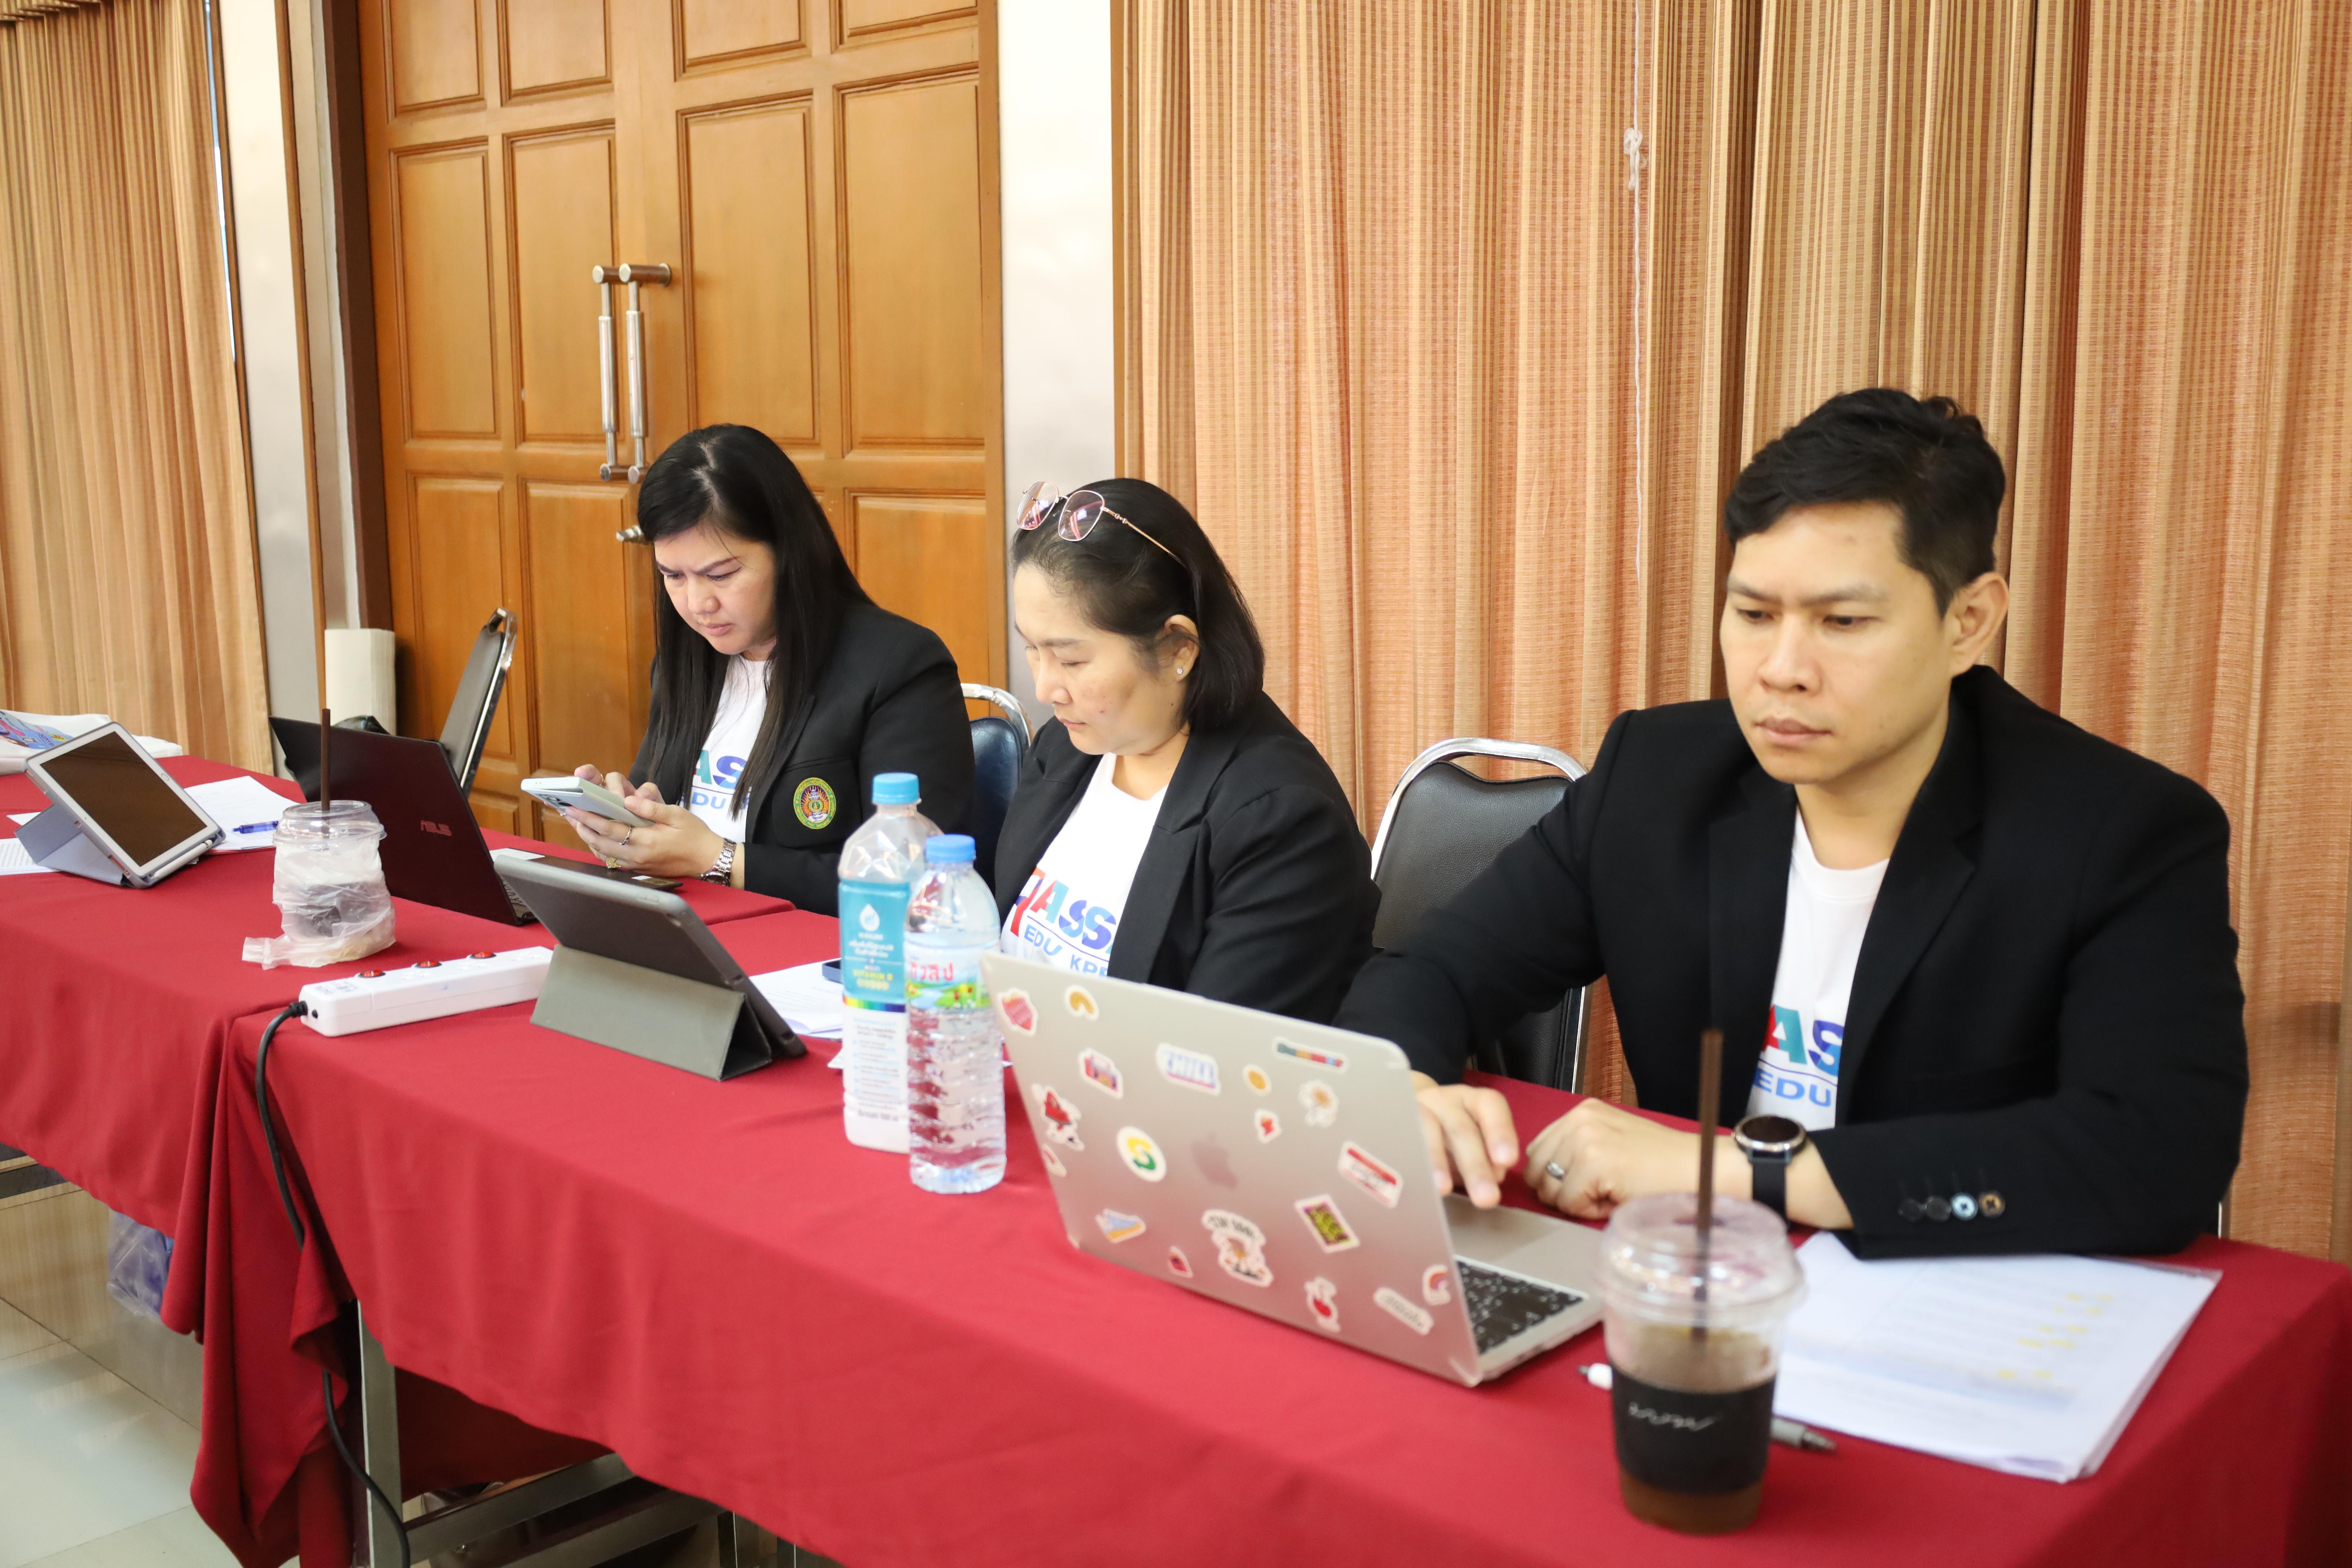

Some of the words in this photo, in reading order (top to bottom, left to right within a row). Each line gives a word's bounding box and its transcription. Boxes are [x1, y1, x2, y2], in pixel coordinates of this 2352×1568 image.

[681, 792, 726, 809] DU
[420, 820, 452, 836] ASUS
[1010, 866, 1116, 954] ASS
[1024, 923, 1063, 956] EDU
[1753, 1067, 1832, 1108] EDU
